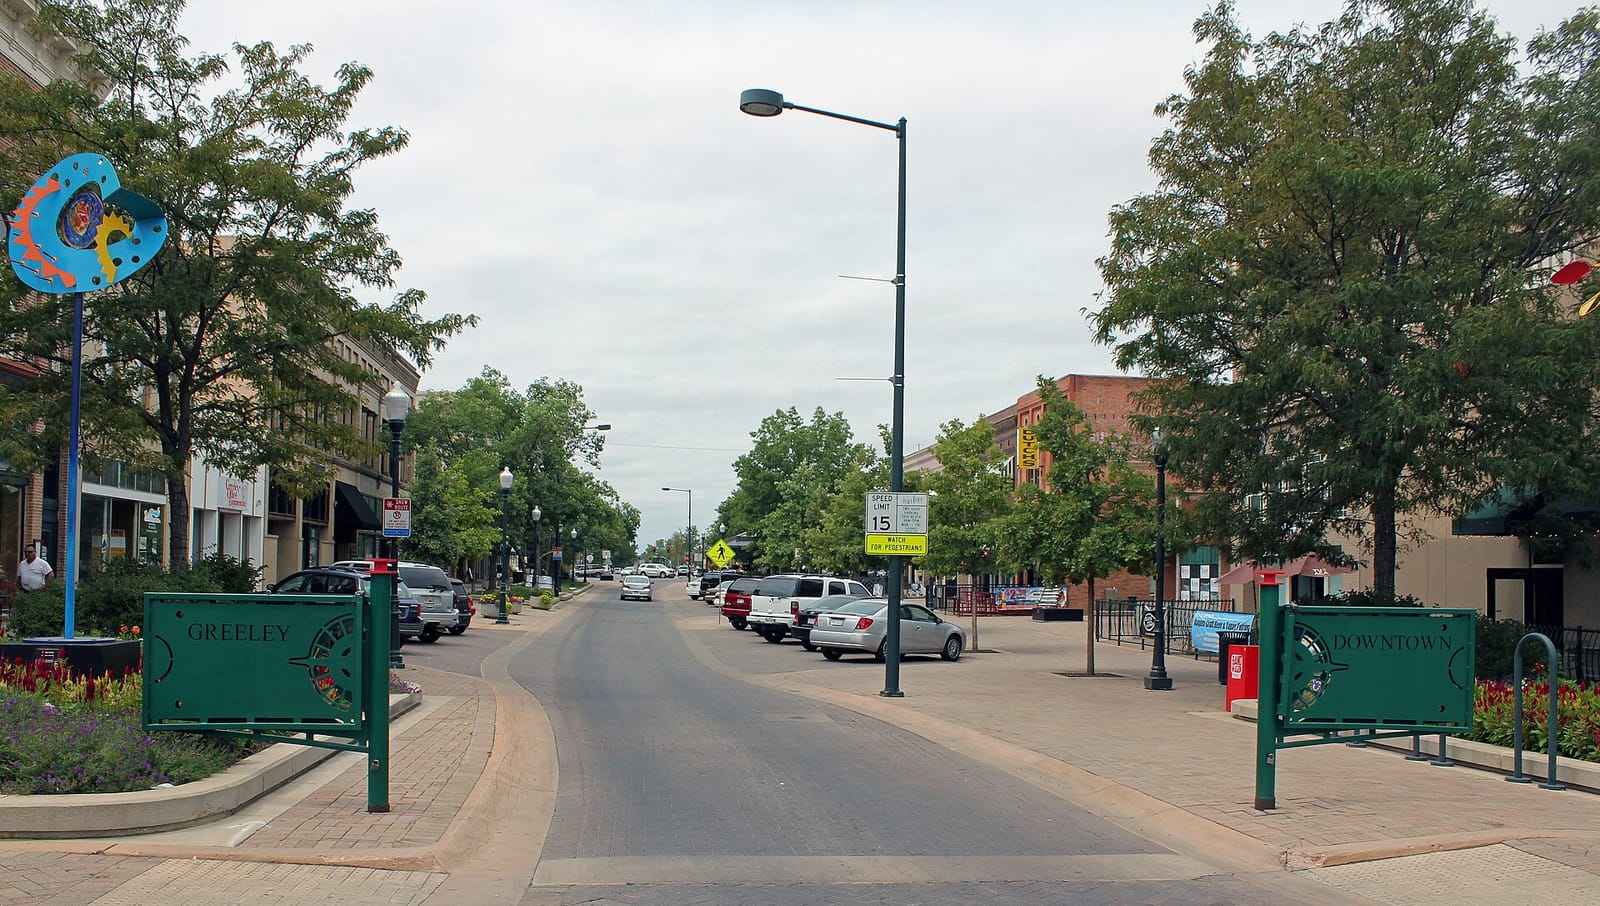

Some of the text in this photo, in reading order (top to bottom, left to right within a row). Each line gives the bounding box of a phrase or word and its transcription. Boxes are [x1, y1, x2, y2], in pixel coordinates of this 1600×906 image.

[872, 516, 891, 531] 15
[187, 623, 291, 642] GREELEY
[1333, 634, 1453, 650] DOWNTOWN
